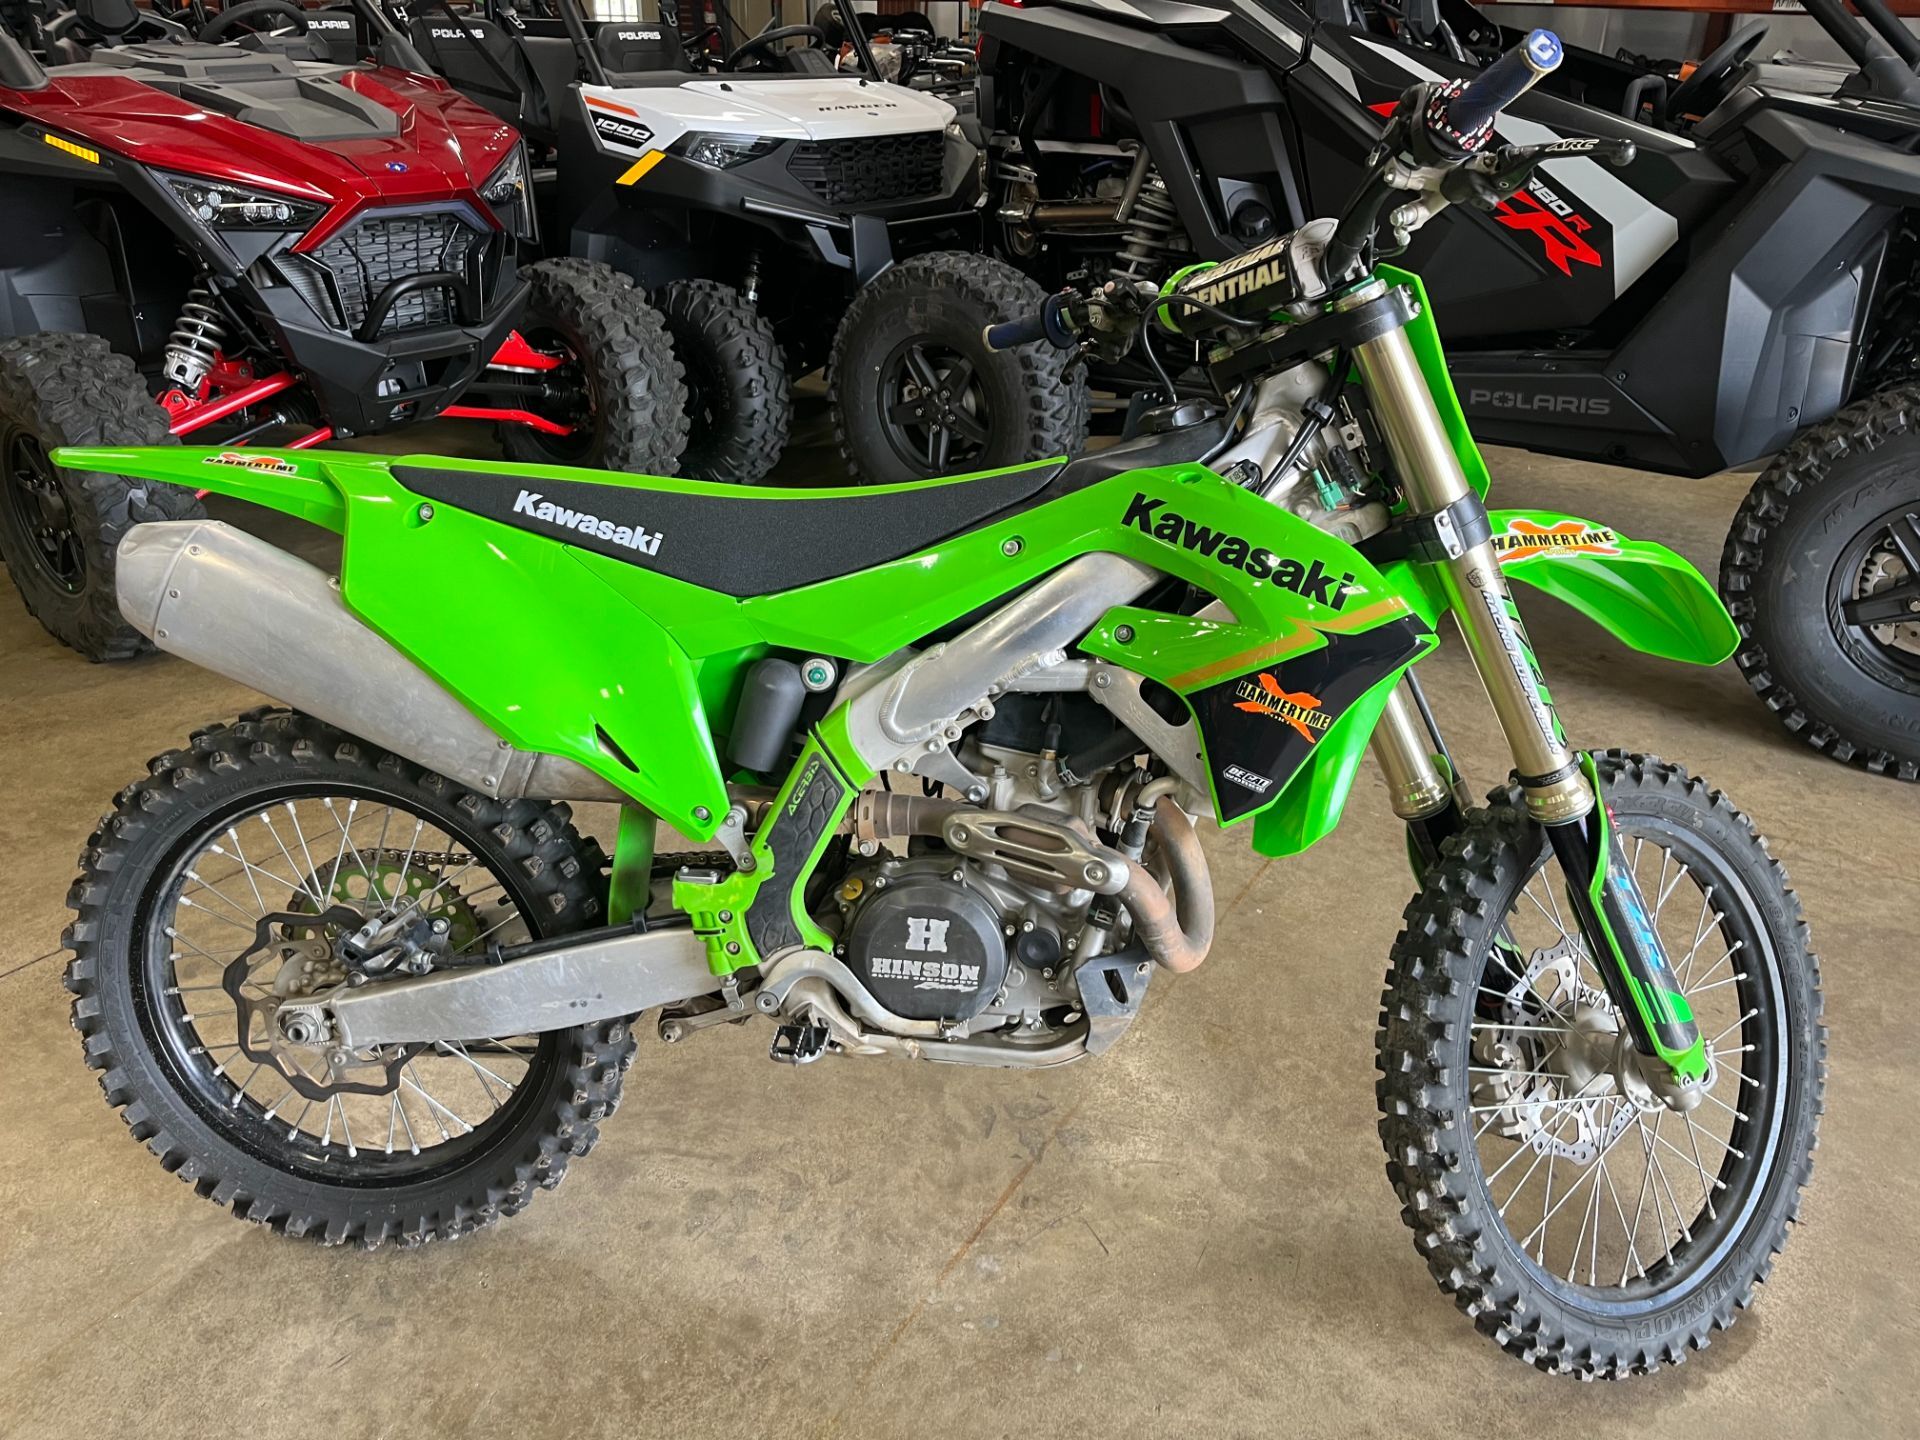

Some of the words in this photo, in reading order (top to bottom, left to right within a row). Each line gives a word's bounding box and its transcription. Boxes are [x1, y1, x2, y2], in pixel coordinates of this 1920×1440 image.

[307, 20, 350, 30] OLARIS
[432, 28, 485, 39] POLAIS
[618, 31, 661, 41] POLARIS
[818, 103, 897, 112] RANGER
[595, 117, 652, 141] 1000
[1545, 137, 1600, 152] ARC
[1469, 389, 1611, 416] POLARIS
[204, 457, 296, 473] HAMMERTIME
[513, 489, 664, 557] Kawasaki
[1490, 530, 1615, 551] HAMMERTIME
[1121, 491, 1355, 613] Kawasaki
[1480, 589, 1517, 652] RACING
[1508, 652, 1562, 755] SUSPENSION
[1238, 682, 1332, 730] HAMMERTIME
[1228, 766, 1272, 787] DECAL
[905, 916, 950, 953] H
[871, 957, 981, 981] HINSON
